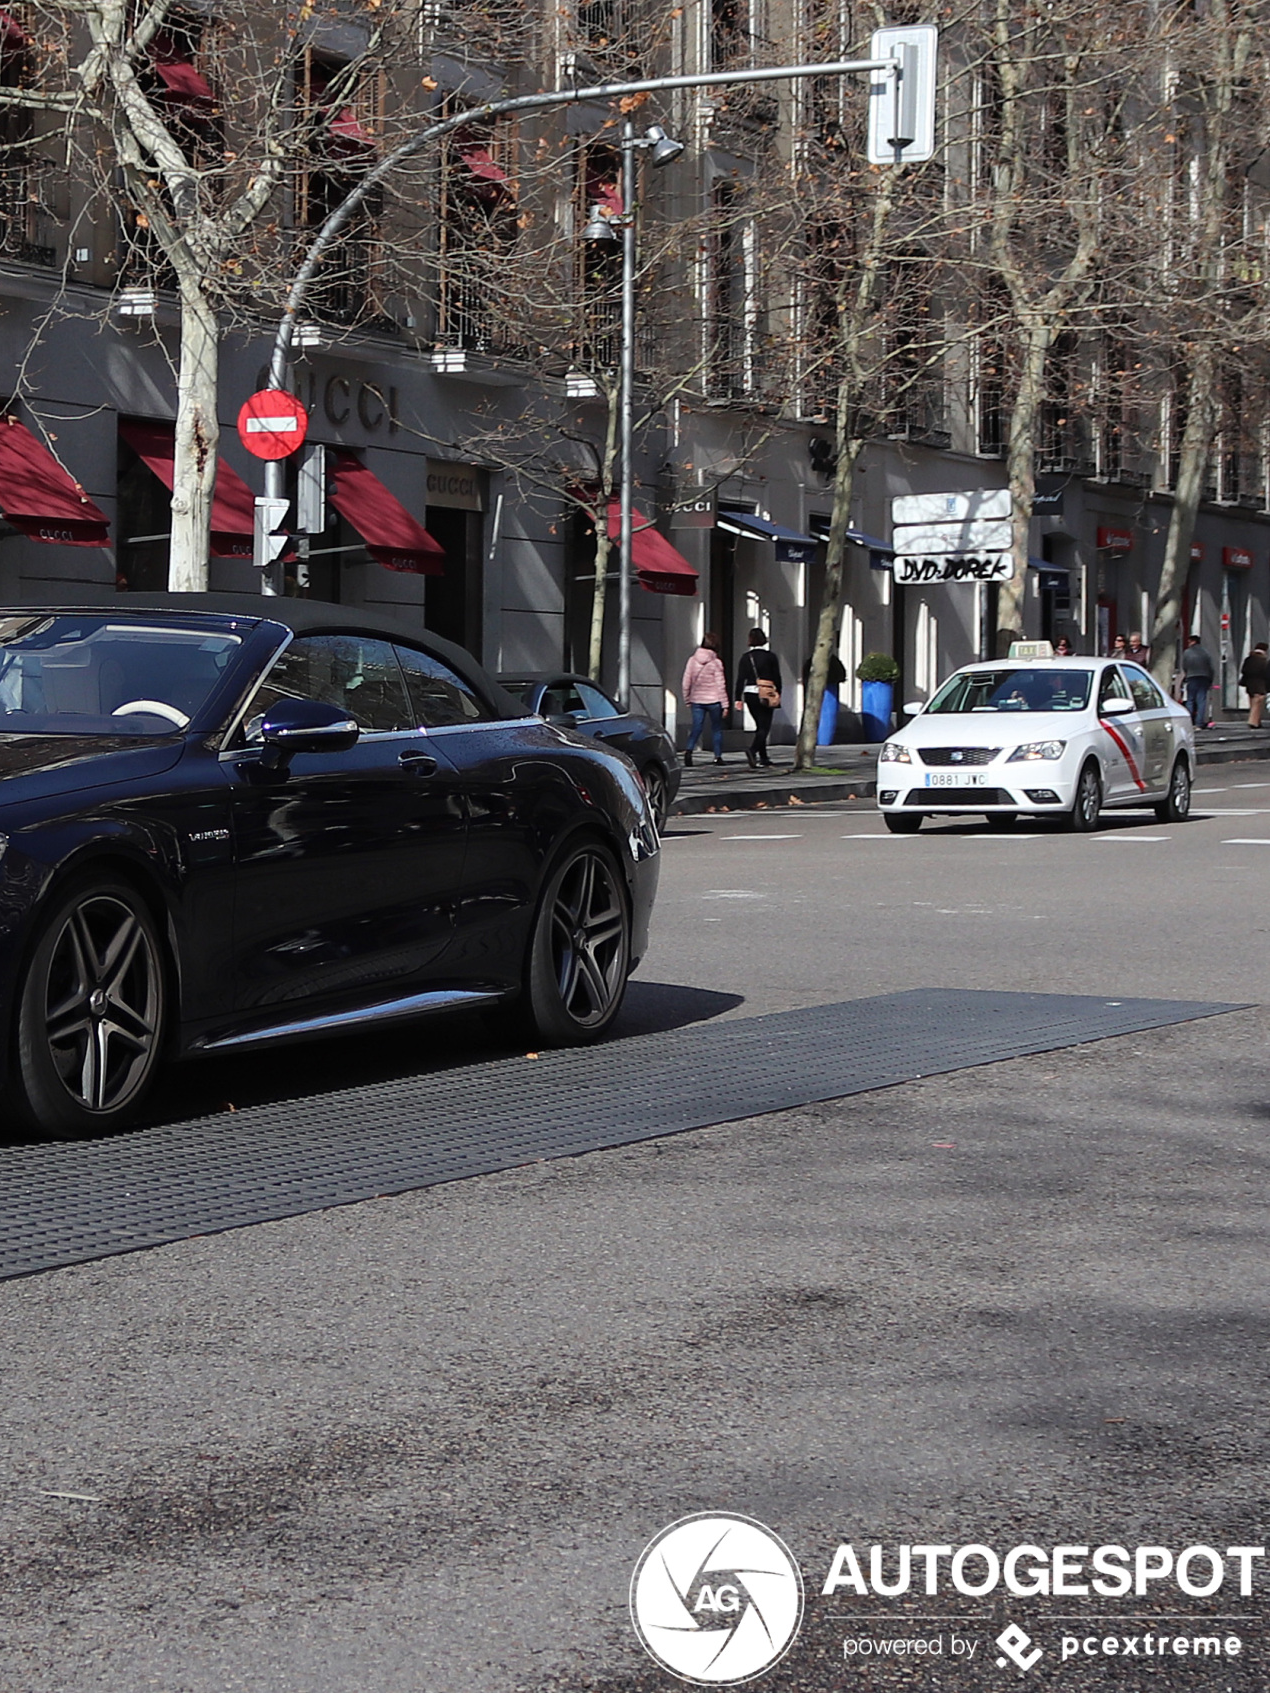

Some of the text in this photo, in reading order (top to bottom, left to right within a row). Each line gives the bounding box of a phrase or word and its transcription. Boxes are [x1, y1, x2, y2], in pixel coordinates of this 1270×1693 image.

[256, 364, 399, 436] UCCI
[426, 474, 475, 496] GUCCI
[39, 528, 74, 541] GUCCI
[931, 774, 986, 786] 0881 JWC
